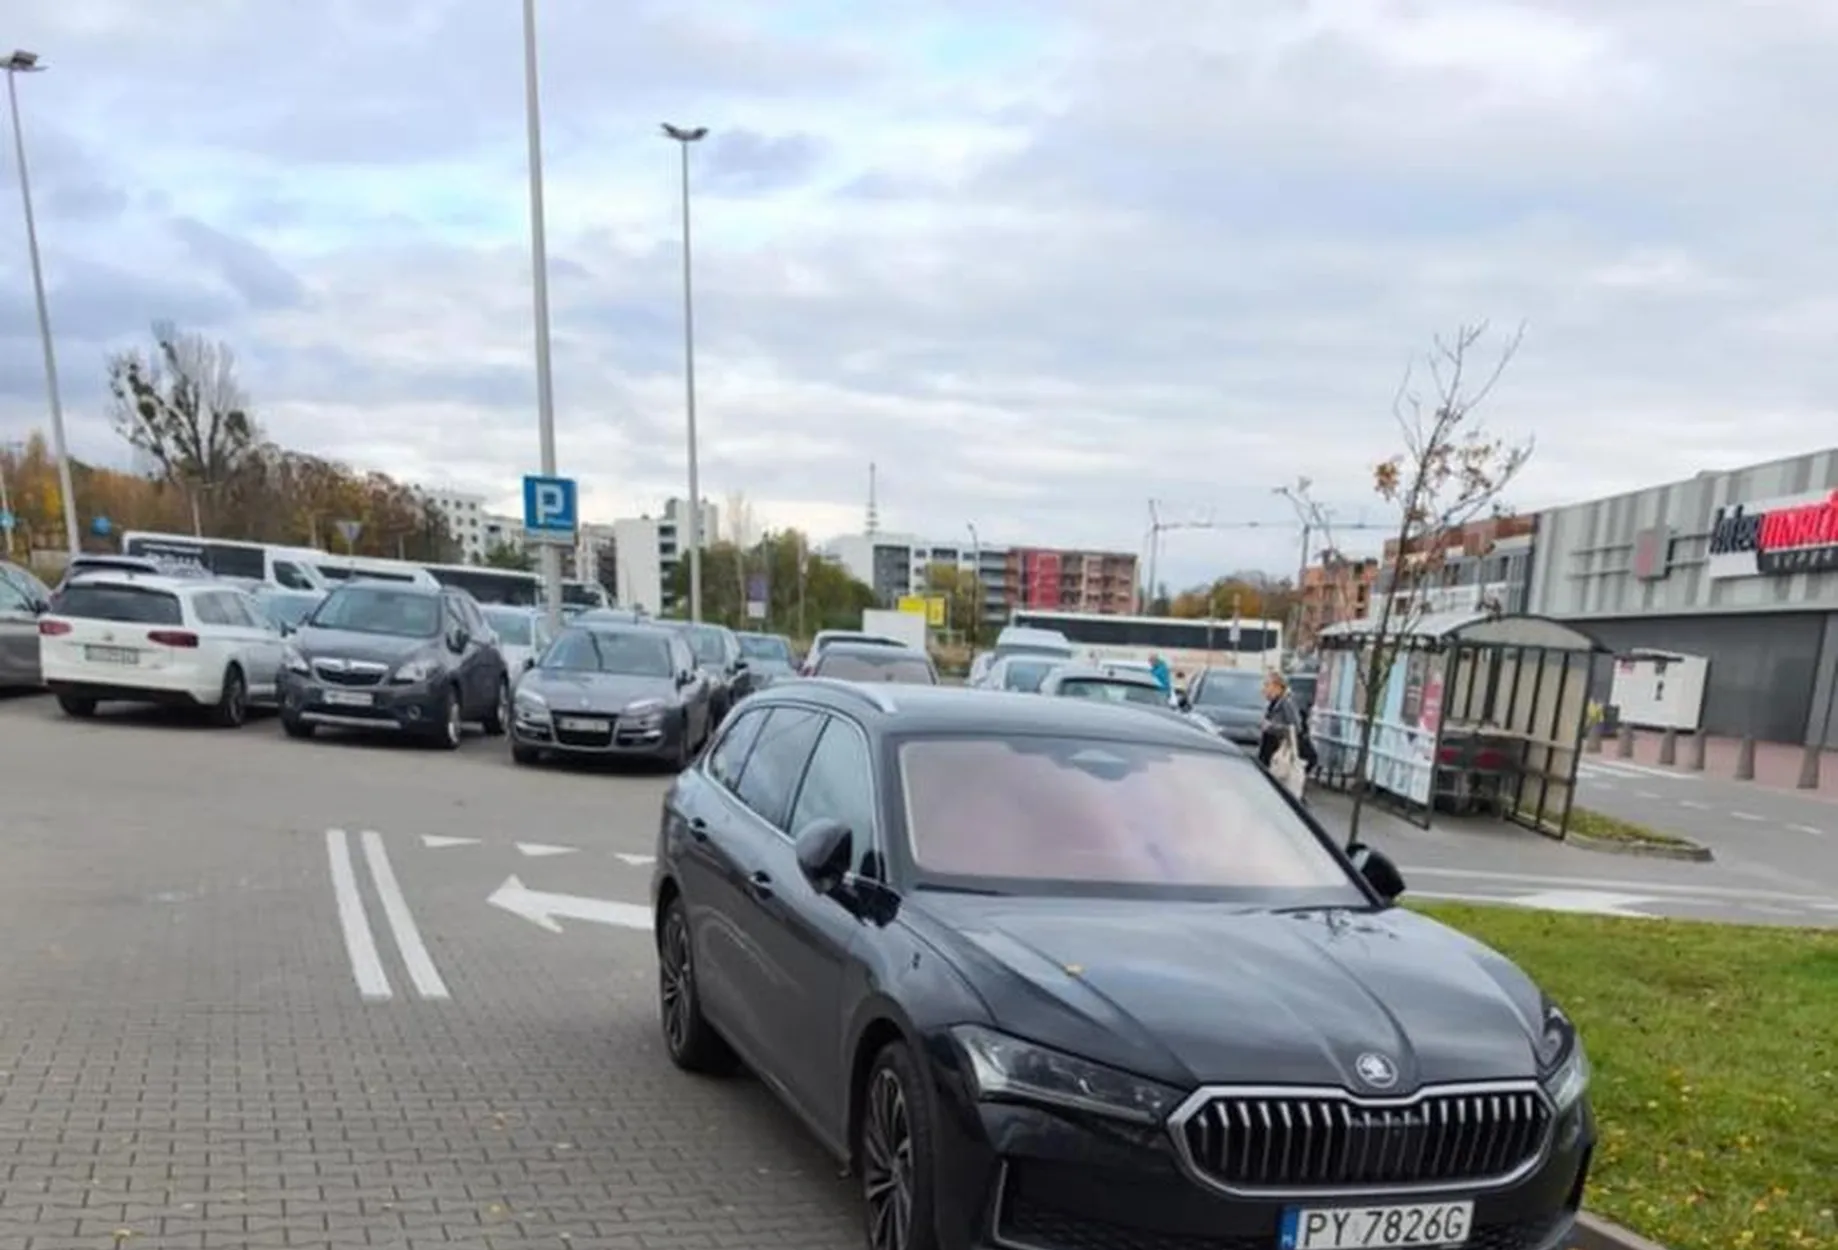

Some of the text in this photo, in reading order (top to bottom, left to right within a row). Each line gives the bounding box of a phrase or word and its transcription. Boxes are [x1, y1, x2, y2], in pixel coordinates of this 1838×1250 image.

[535, 482, 565, 525] P
[1304, 1212, 1350, 1247] PY
[1361, 1205, 1465, 1245] 7826G
